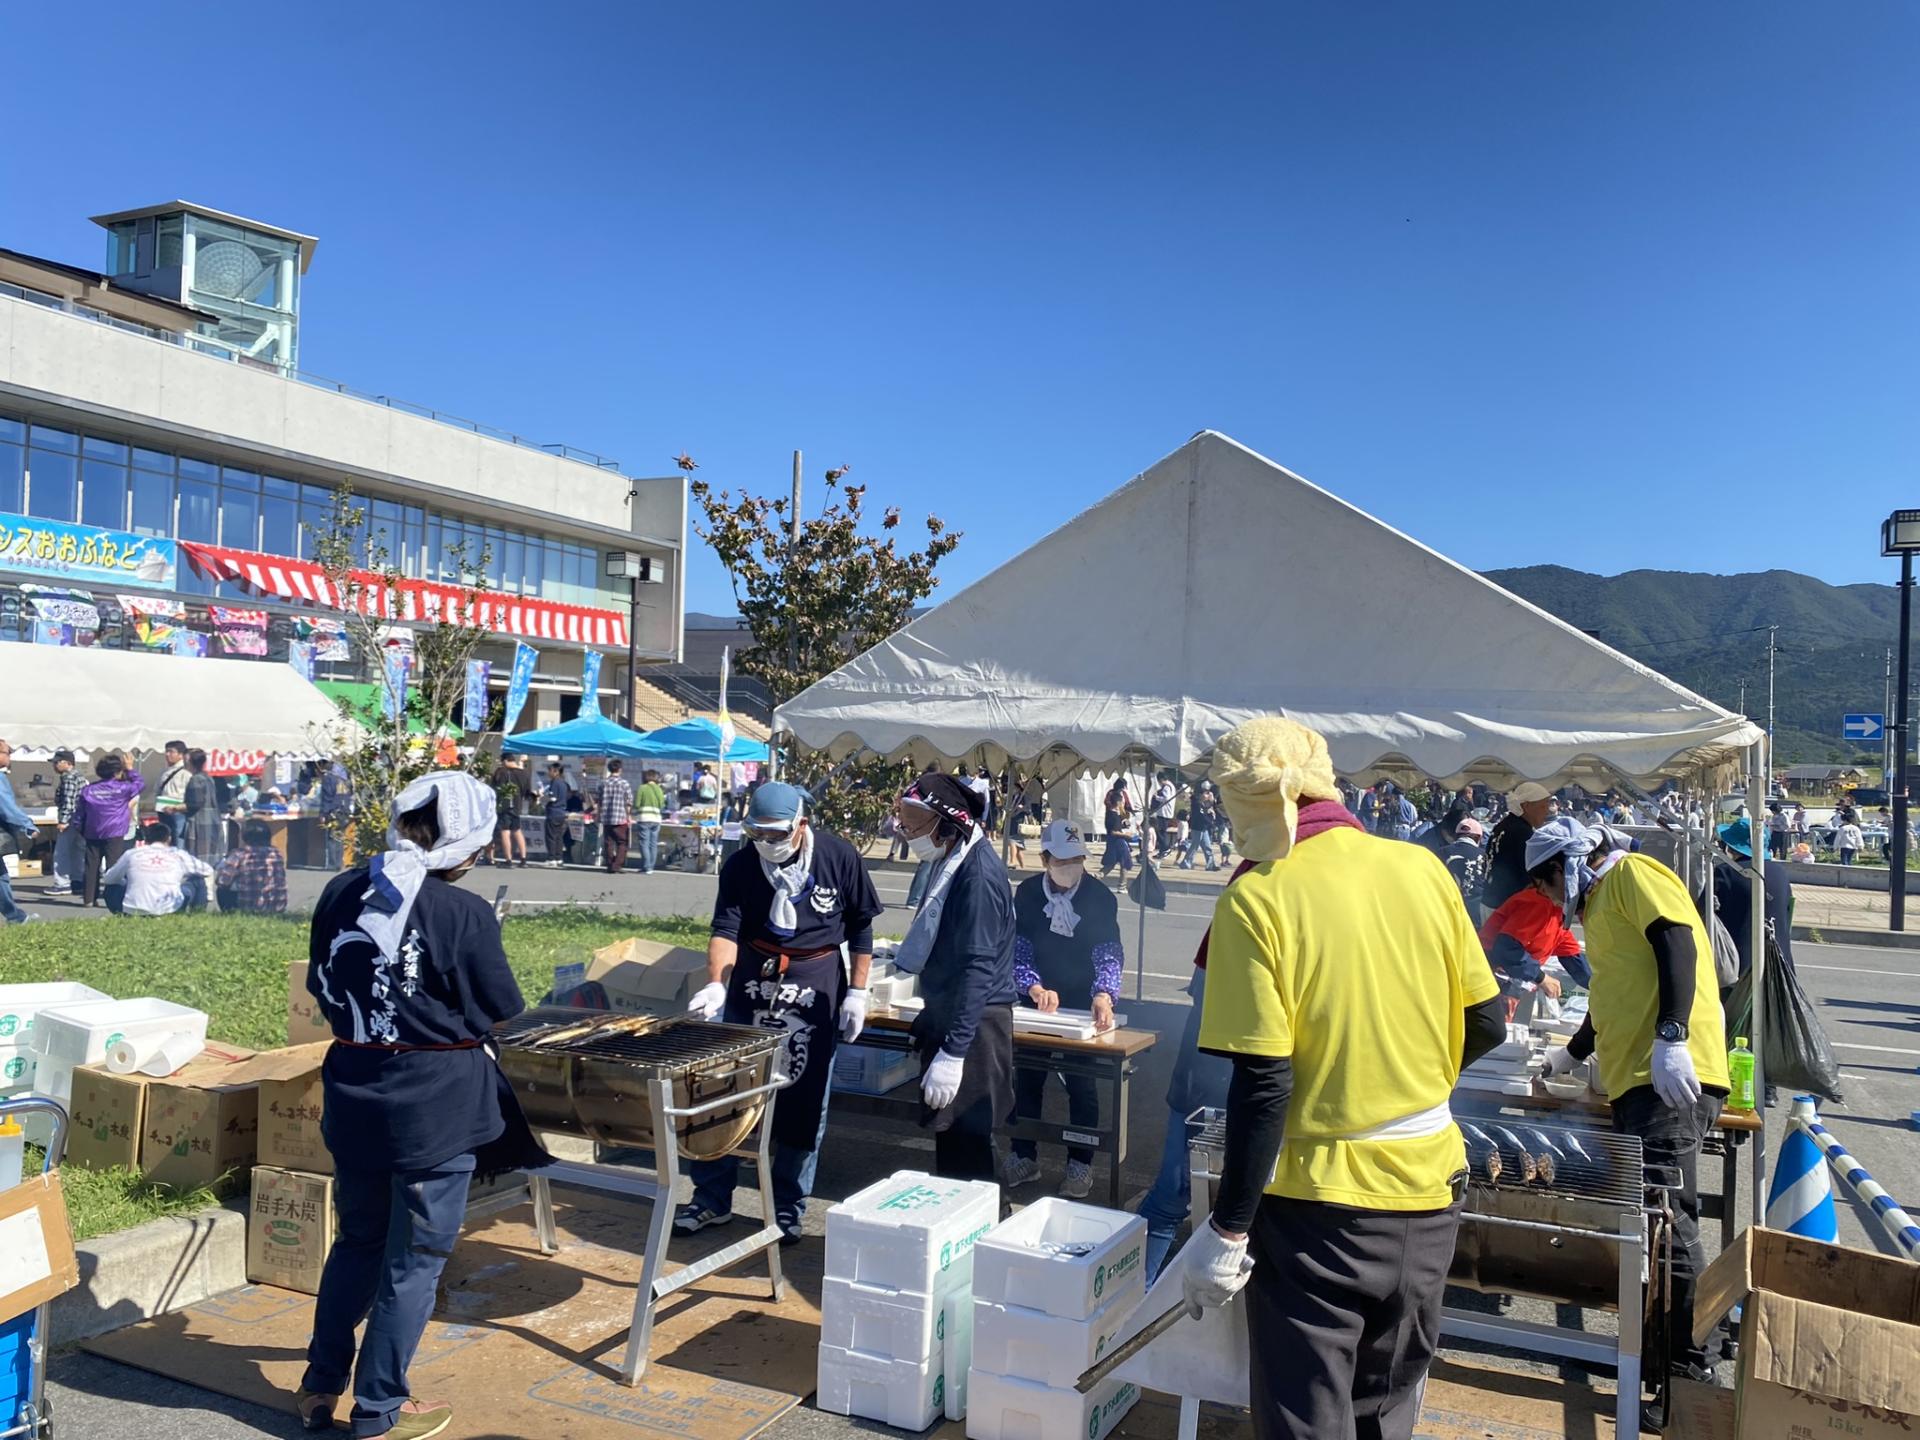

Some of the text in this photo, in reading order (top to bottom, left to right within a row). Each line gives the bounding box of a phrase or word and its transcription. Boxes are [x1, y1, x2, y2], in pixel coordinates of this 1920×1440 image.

[255, 1193, 317, 1222] 岩手木炭
[1827, 1415, 1865, 1436] 15kg
